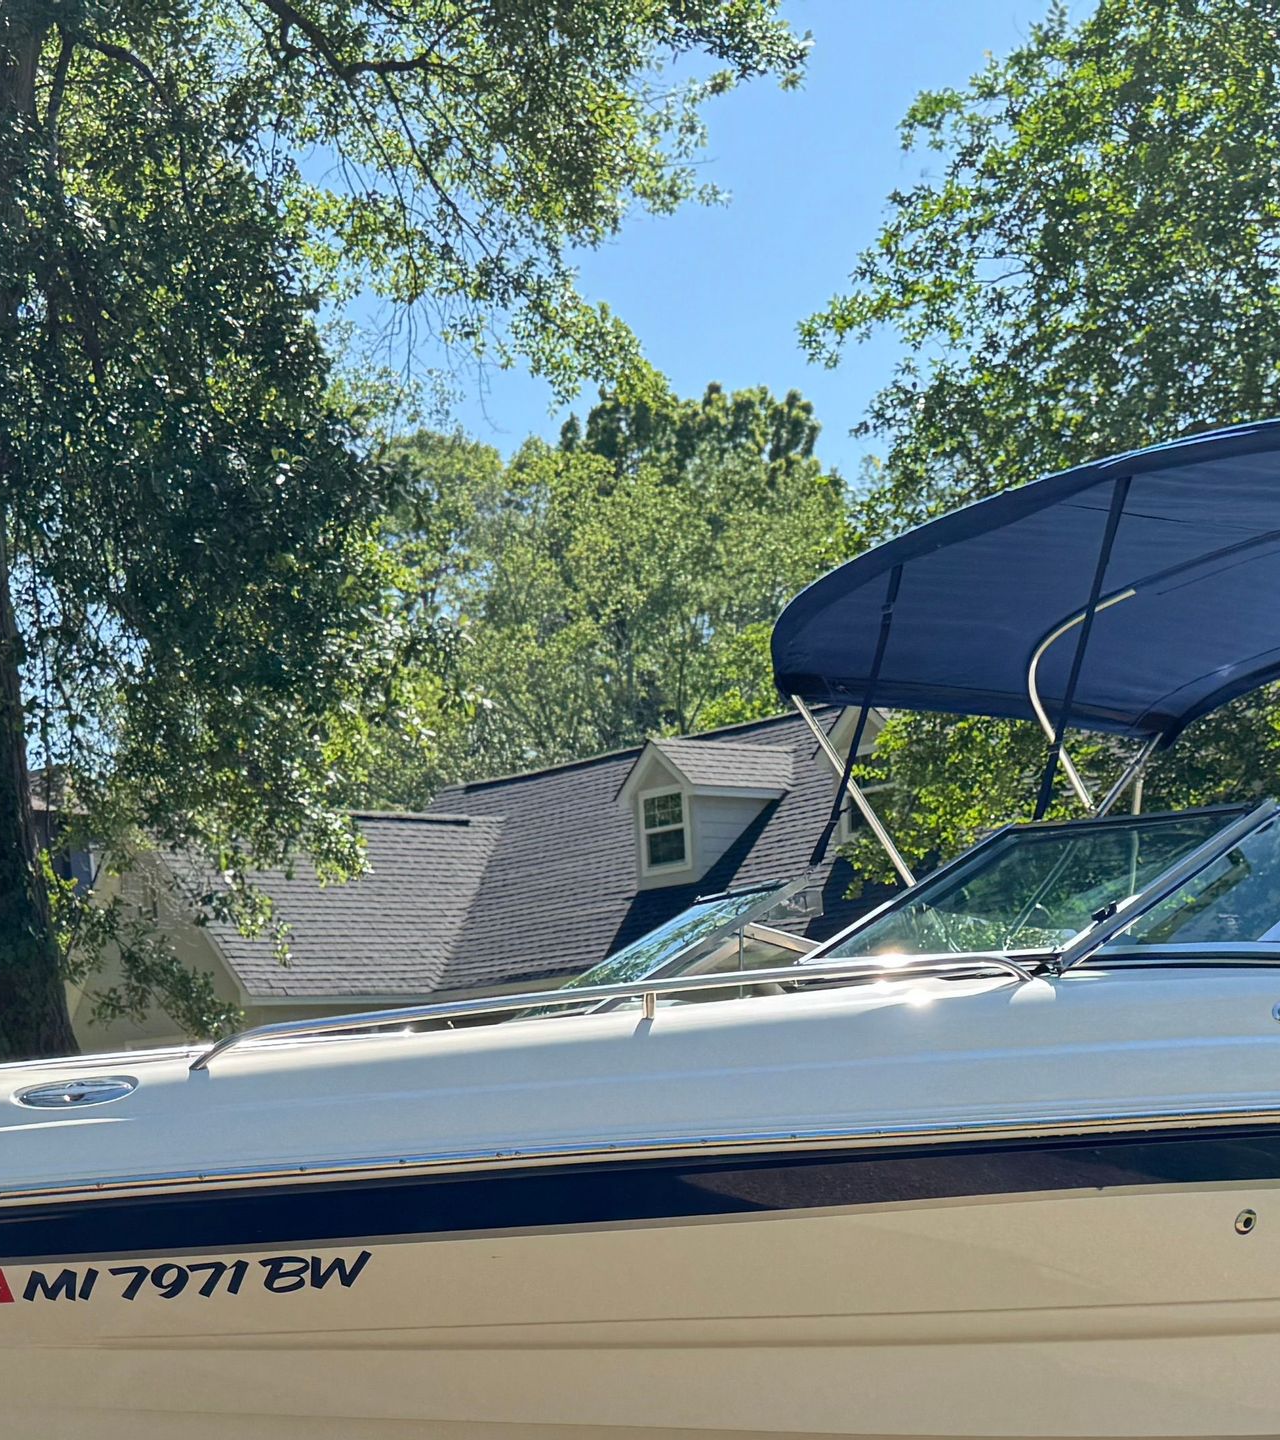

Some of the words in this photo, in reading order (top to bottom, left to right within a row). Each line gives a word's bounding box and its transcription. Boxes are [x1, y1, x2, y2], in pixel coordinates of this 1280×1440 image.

[22, 1267, 100, 1301] MI
[107, 1259, 250, 1301] 7971
[258, 1250, 373, 1294] BW
